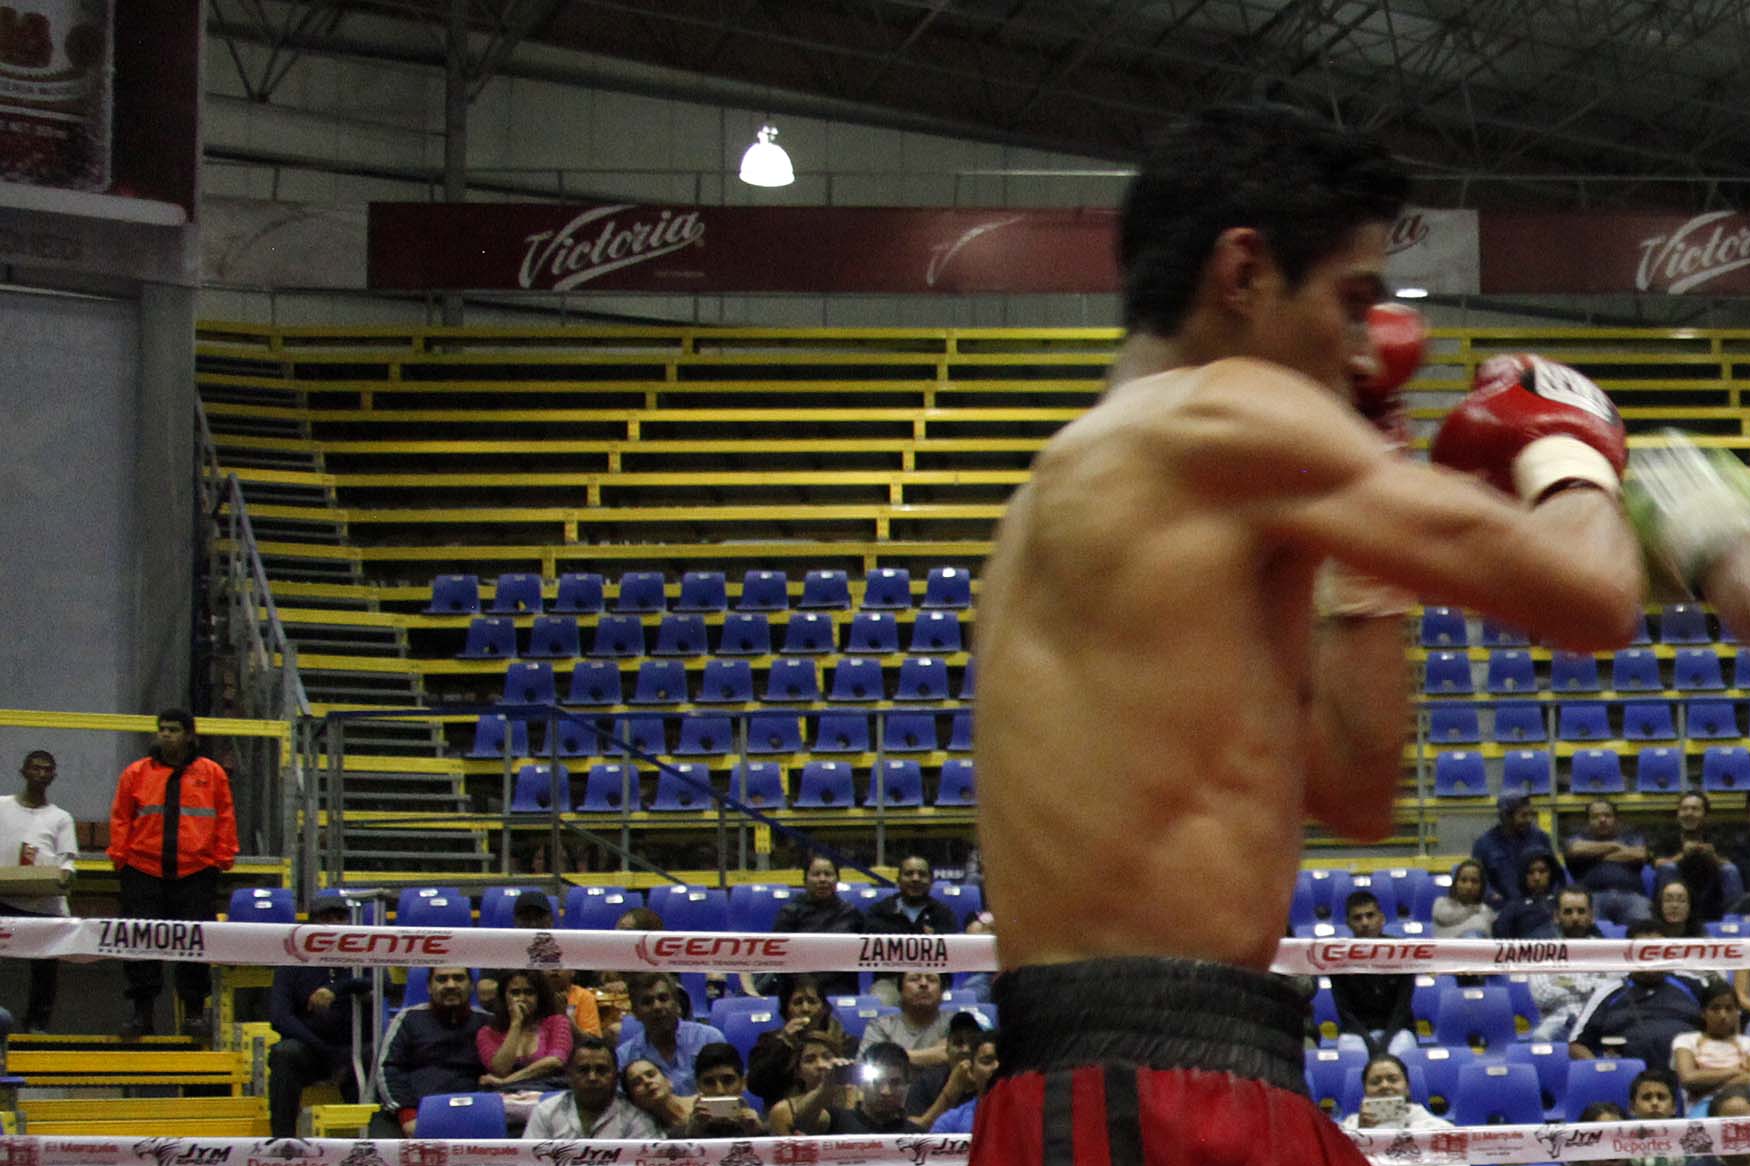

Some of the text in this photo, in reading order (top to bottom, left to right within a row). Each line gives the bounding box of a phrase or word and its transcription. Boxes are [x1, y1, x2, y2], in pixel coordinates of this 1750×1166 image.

[519, 204, 705, 291] Victoria
[99, 921, 205, 950] ZAMORA
[304, 932, 453, 955] GENTE
[655, 937, 790, 956] GENTE
[859, 937, 948, 961] ZAMORA
[1322, 944, 1438, 961] GENTE
[1495, 943, 1568, 963] ZAMORA
[1638, 944, 1744, 961] GENTE
[1568, 1130, 1603, 1143] JYM
[178, 1144, 234, 1161] JYM
[574, 1146, 622, 1163] JYM
[1613, 1139, 1673, 1154] Deportes
